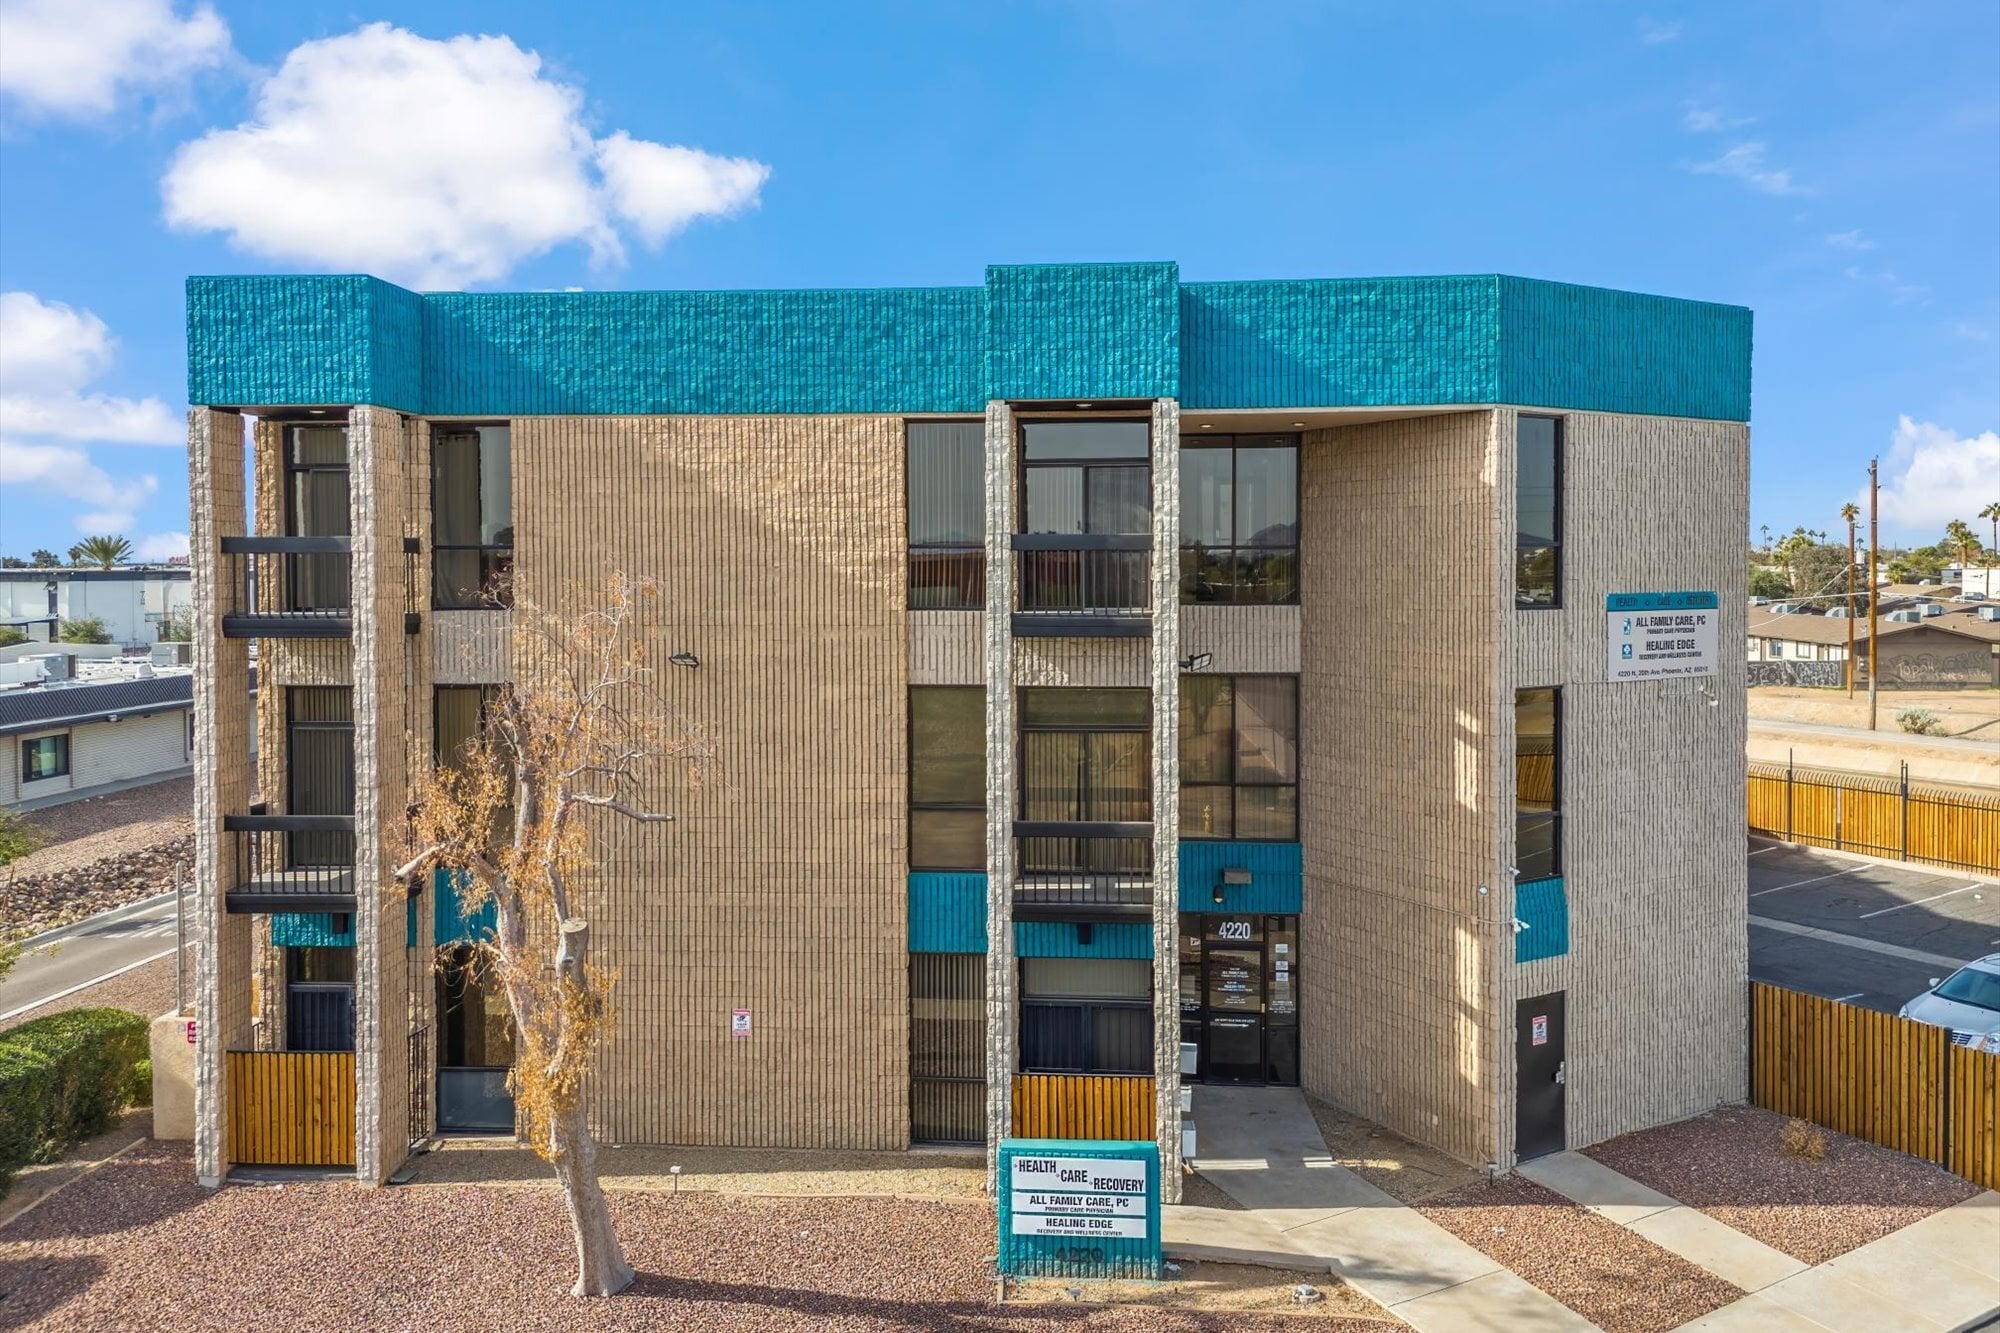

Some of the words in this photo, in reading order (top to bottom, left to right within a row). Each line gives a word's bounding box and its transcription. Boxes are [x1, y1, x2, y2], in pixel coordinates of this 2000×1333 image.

[1636, 617, 1649, 627] ALL
[1650, 616, 1674, 627] FAMILY
[1674, 615, 1695, 627] CARE,
[1696, 615, 1706, 625] PC
[1646, 640, 1675, 651] HEALING
[1677, 639, 1695, 650] EDGE
[1219, 921, 1251, 939] 4220
[1019, 1159, 1057, 1173] HEALTH
[1060, 1169, 1088, 1183] CARE
[1093, 1178, 1144, 1192] RECOVERY
[1029, 1195, 1047, 1205] ALL
[1050, 1196, 1083, 1206] FAMILY
[1086, 1197, 1114, 1208] CARE,
[1116, 1198, 1129, 1207] PC
[1046, 1218, 1086, 1228] HEALING
[1088, 1219, 1113, 1229] EDGE
